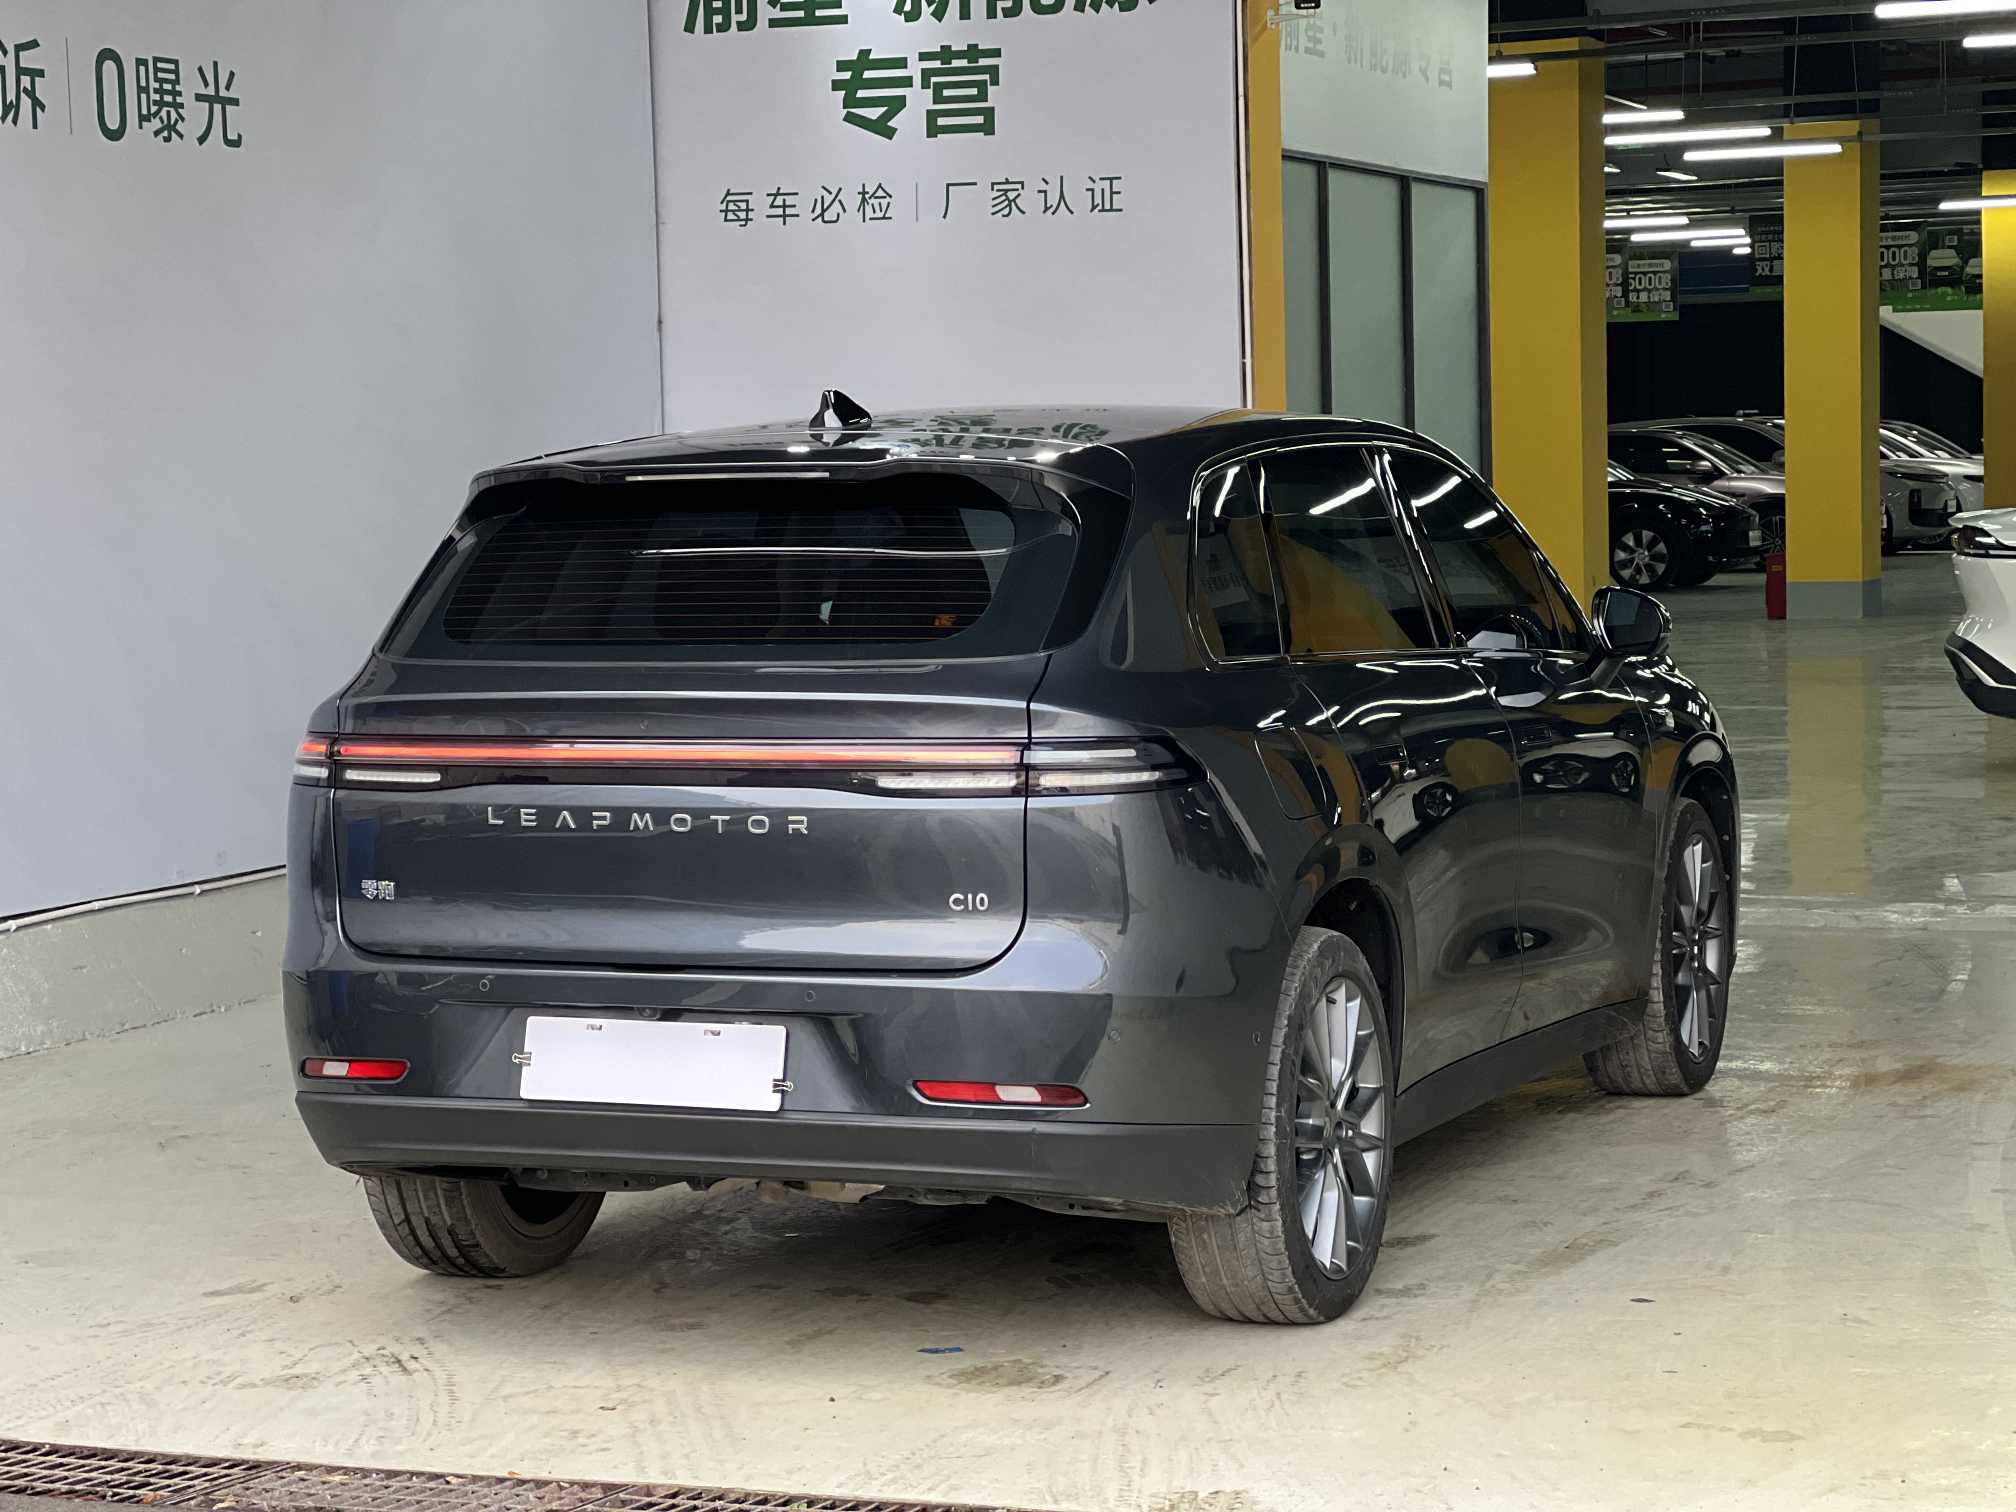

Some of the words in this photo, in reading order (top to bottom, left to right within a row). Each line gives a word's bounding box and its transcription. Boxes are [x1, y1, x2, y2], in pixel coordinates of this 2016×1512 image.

[0, 38, 47, 131] 诉
[95, 47, 244, 149] 0曝光
[831, 43, 1003, 141] 专营
[718, 183, 895, 229] 每车必检
[941, 175, 1126, 221] 厂家认证
[487, 806, 810, 835] LEAPMOTOR
